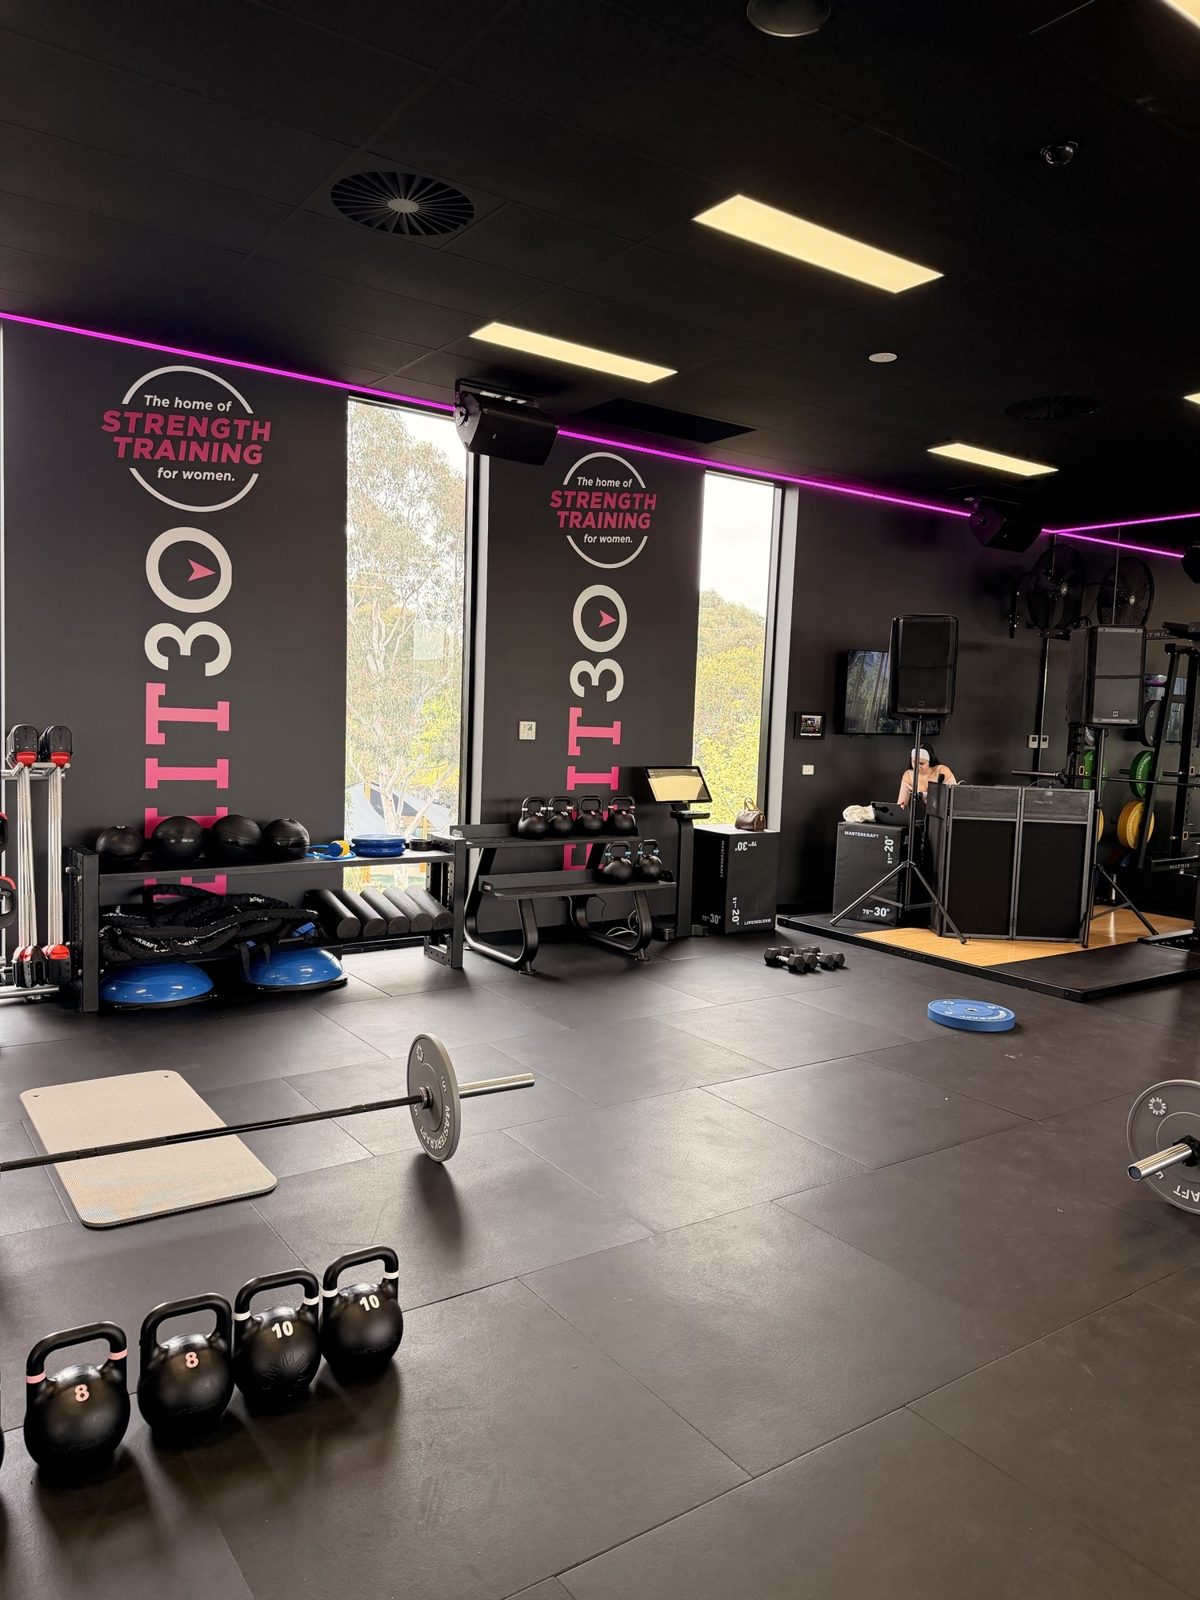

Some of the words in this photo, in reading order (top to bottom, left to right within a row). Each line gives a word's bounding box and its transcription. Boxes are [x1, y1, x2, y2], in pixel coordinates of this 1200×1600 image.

[144, 394, 170, 407] The
[174, 397, 213, 411] home
[217, 400, 232, 412] of
[101, 409, 271, 442] STRENGTH
[113, 436, 263, 465] TRAINING
[157, 467, 178, 479] for
[182, 470, 235, 482] women.
[577, 476, 593, 486] The
[595, 477, 620, 488] home
[622, 478, 633, 488] of
[550, 490, 656, 510] STRENGTH
[557, 511, 651, 529] TRAINING
[583, 533, 597, 544] for
[599, 535, 633, 544] women.
[844, 830, 879, 839] MASTERKRAFT
[357, 1294, 380, 1311] 10
[271, 1320, 294, 1339] 10
[185, 1351, 199, 1368] 8
[74, 1384, 90, 1402] 8
